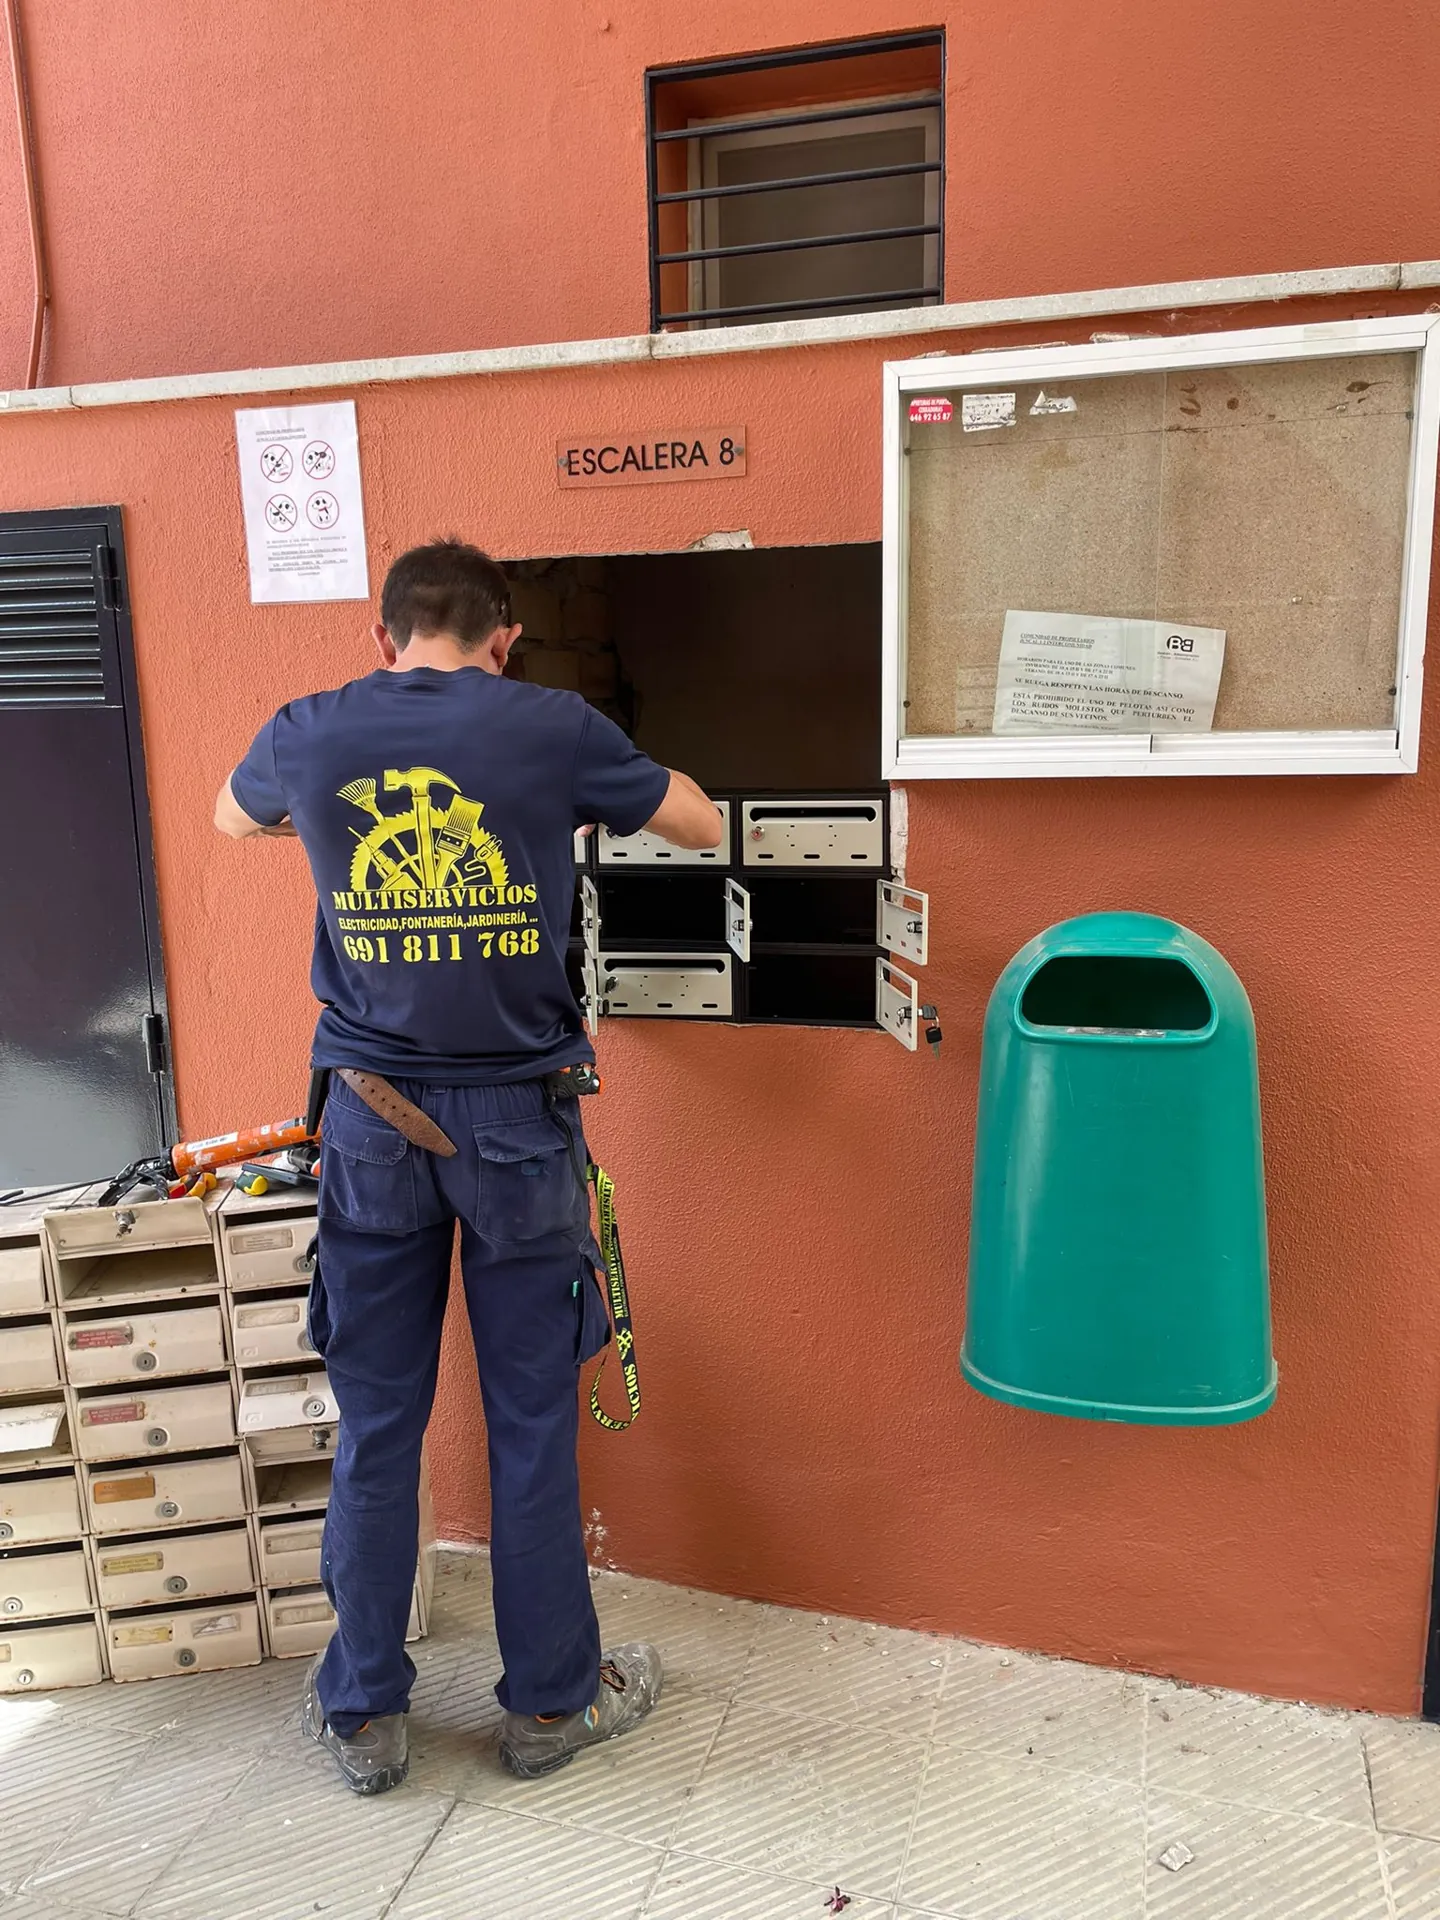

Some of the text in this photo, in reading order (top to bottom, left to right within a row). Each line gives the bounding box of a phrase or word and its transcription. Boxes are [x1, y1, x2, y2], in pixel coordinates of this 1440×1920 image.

[567, 438, 734, 476] ESCALERA 8
[1050, 681, 1088, 690] RESPETEN
[1034, 694, 1074, 703] PROHIBIDO
[1012, 708, 1049, 716] DESCANSO
[1032, 702, 1059, 710] RUIDOS
[1065, 704, 1104, 714] MOLESTOS
[1132, 710, 1177, 720] PERTURBEN
[332, 884, 537, 911] MULTISERVICIOS
[344, 929, 540, 963] 691 811 768
